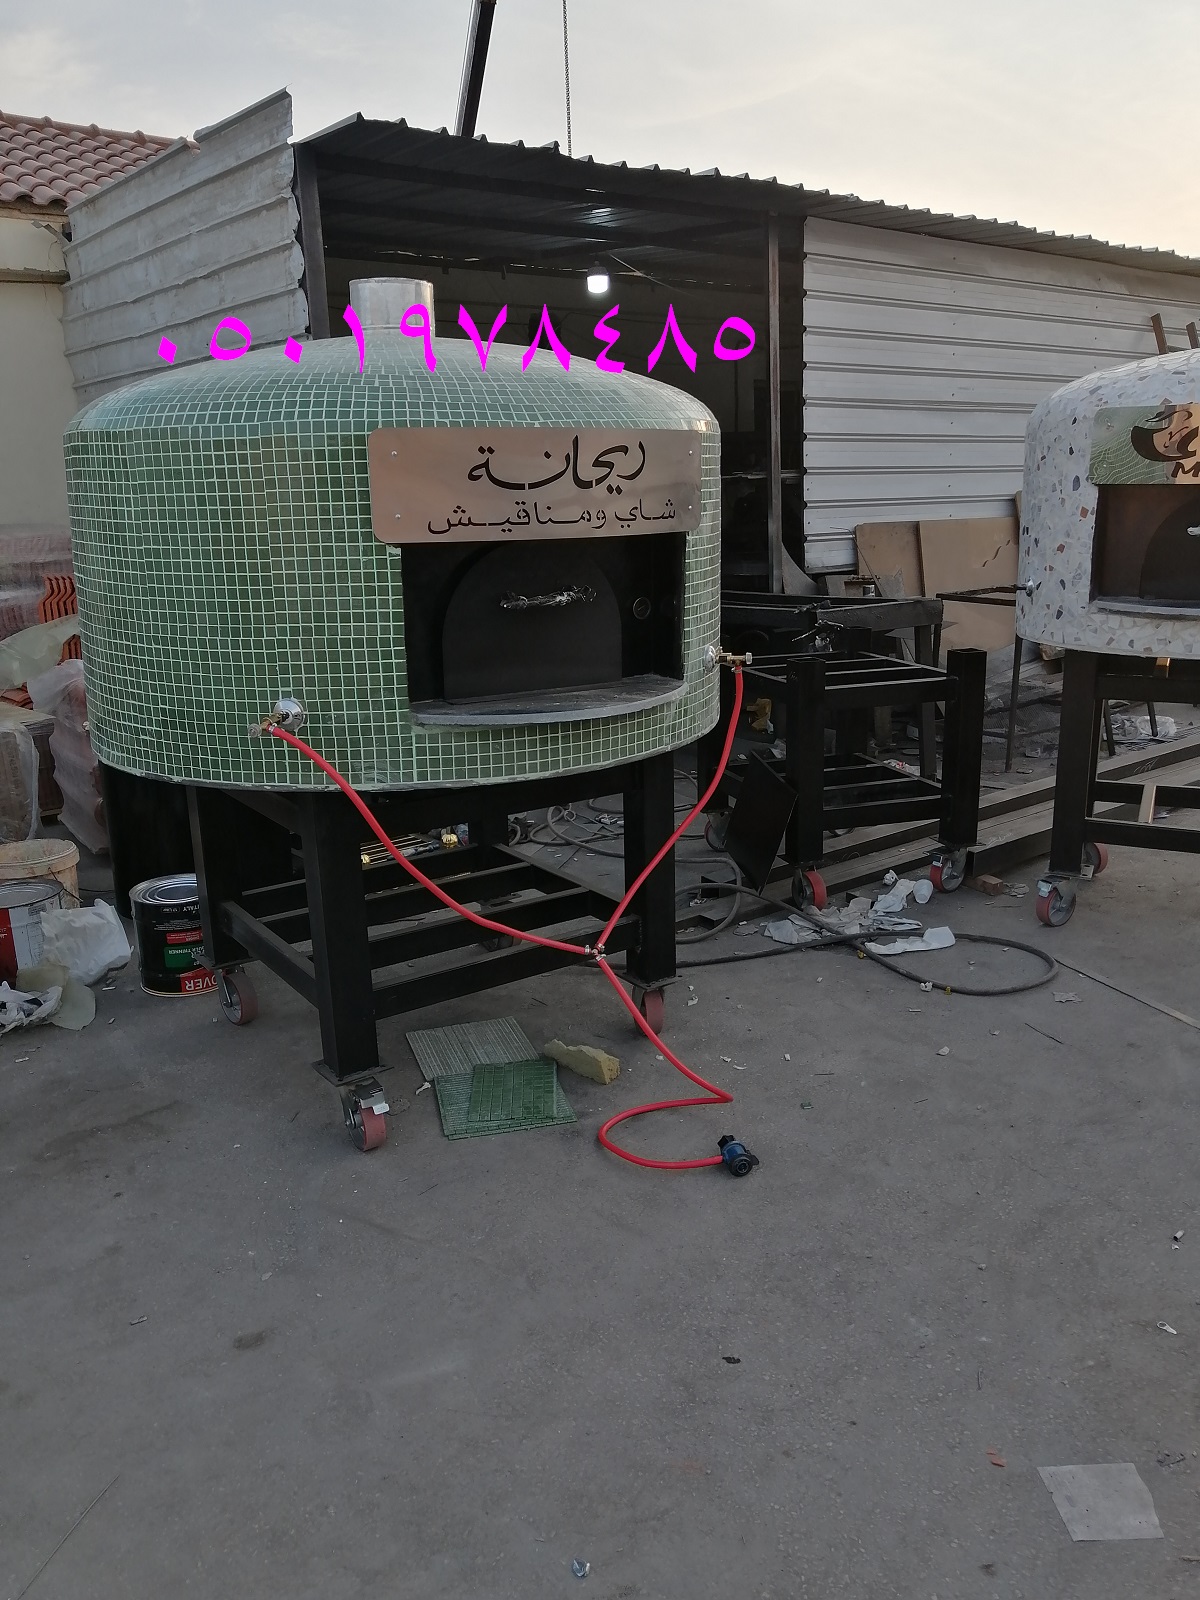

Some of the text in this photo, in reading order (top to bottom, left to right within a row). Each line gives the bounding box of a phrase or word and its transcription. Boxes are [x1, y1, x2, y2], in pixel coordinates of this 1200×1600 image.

[467, 434, 646, 496] ريحانة
[427, 498, 677, 535] شاي ومناقيش
